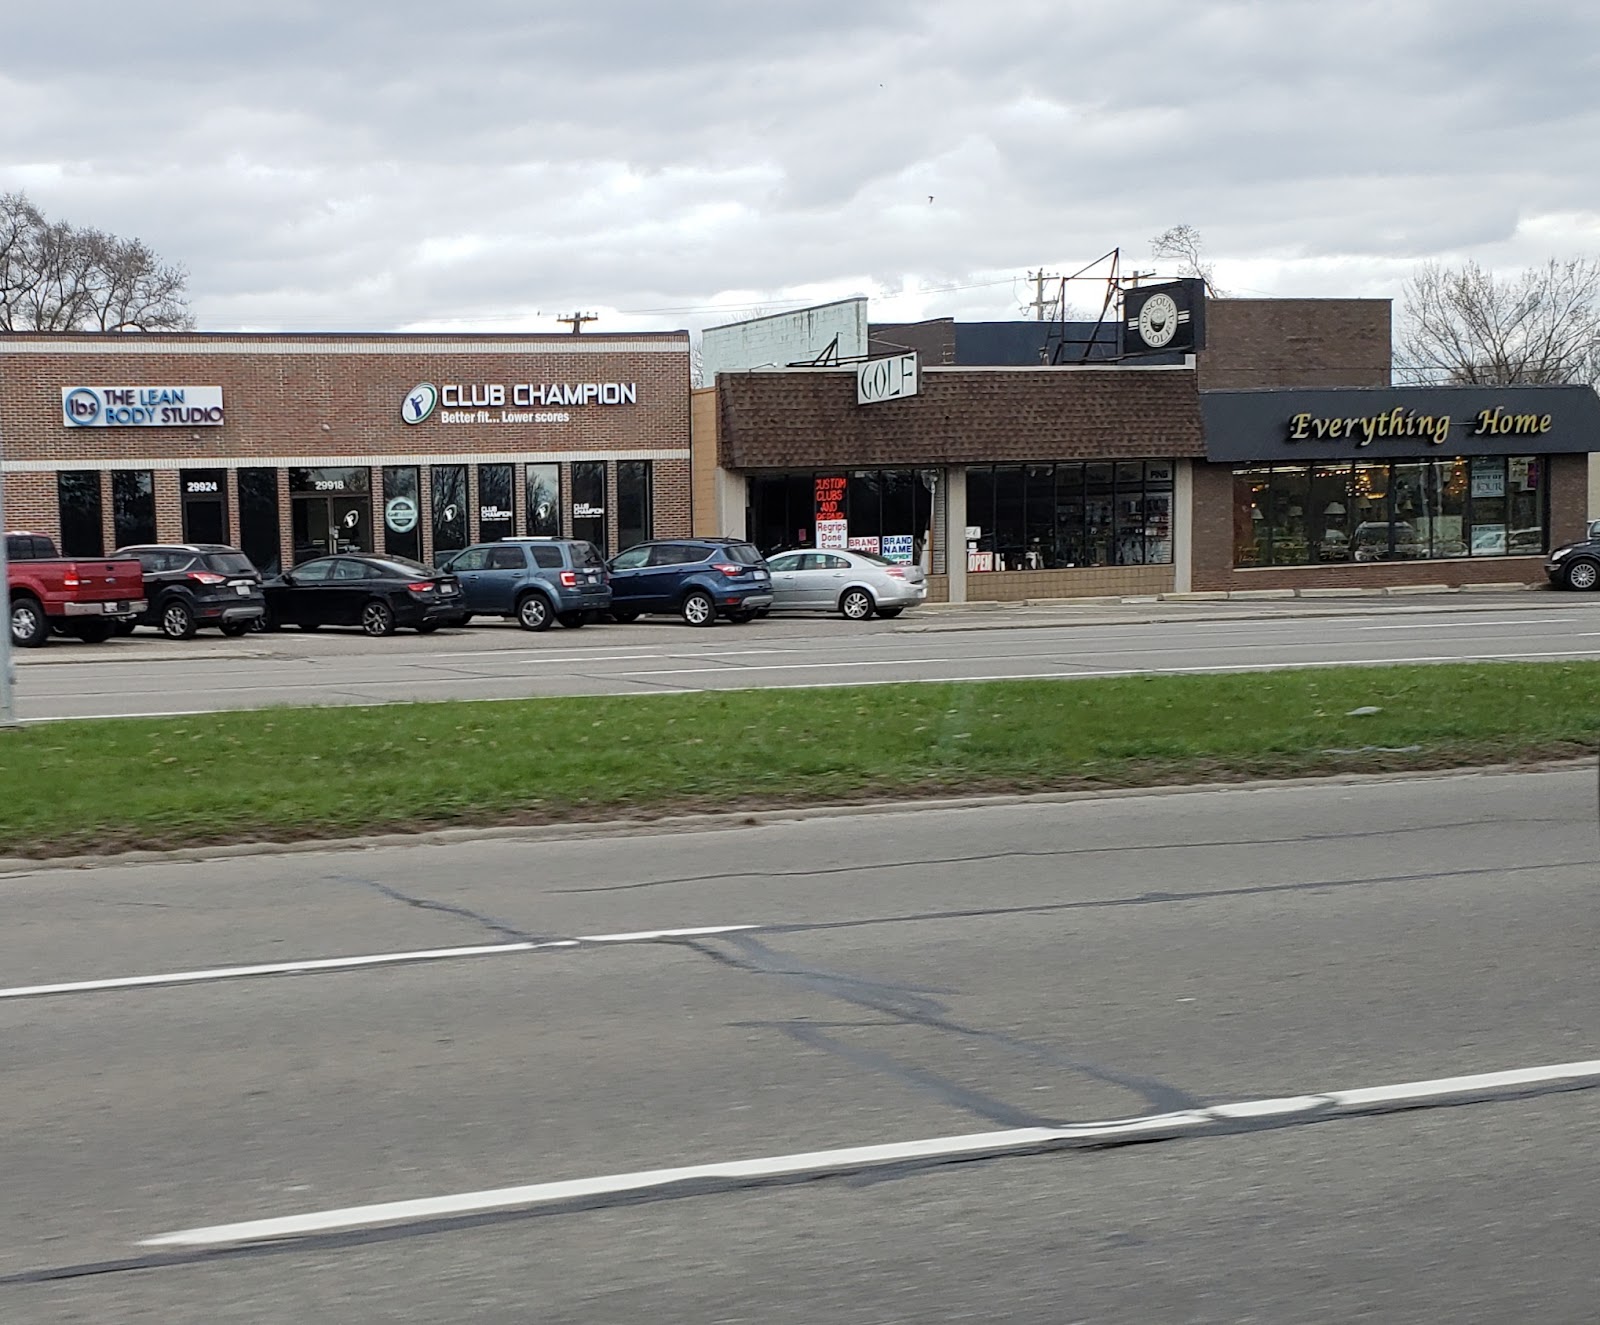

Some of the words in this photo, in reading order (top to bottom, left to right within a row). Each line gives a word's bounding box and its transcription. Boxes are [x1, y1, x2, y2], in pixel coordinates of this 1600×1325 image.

[1141, 297, 1175, 323] DISCOUNT
[1145, 325, 1173, 344] GOLF
[861, 355, 915, 399] GOLF
[103, 389, 135, 405] THE
[140, 389, 184, 405] LEAN
[441, 384, 505, 407] CLUB
[513, 383, 637, 406] CHAMPION
[105, 407, 156, 424] BODY
[161, 407, 224, 423] STUDIO
[441, 411, 475, 424] Better
[502, 411, 534, 422] Lower
[535, 411, 570, 422] scores
[1291, 407, 1451, 446] Everything
[1475, 406, 1552, 434] Home
[187, 481, 218, 492] 29924
[315, 480, 344, 490] 29918
[816, 478, 847, 489] CUSTOM
[816, 490, 843, 501] CLUBS
[820, 501, 838, 512] AND
[817, 522, 847, 533] Regrips
[821, 533, 842, 542] Done
[849, 538, 878, 547] BRAND
[884, 537, 913, 545] BRAND
[884, 545, 912, 554] NAME
[969, 554, 992, 571] OPEN
